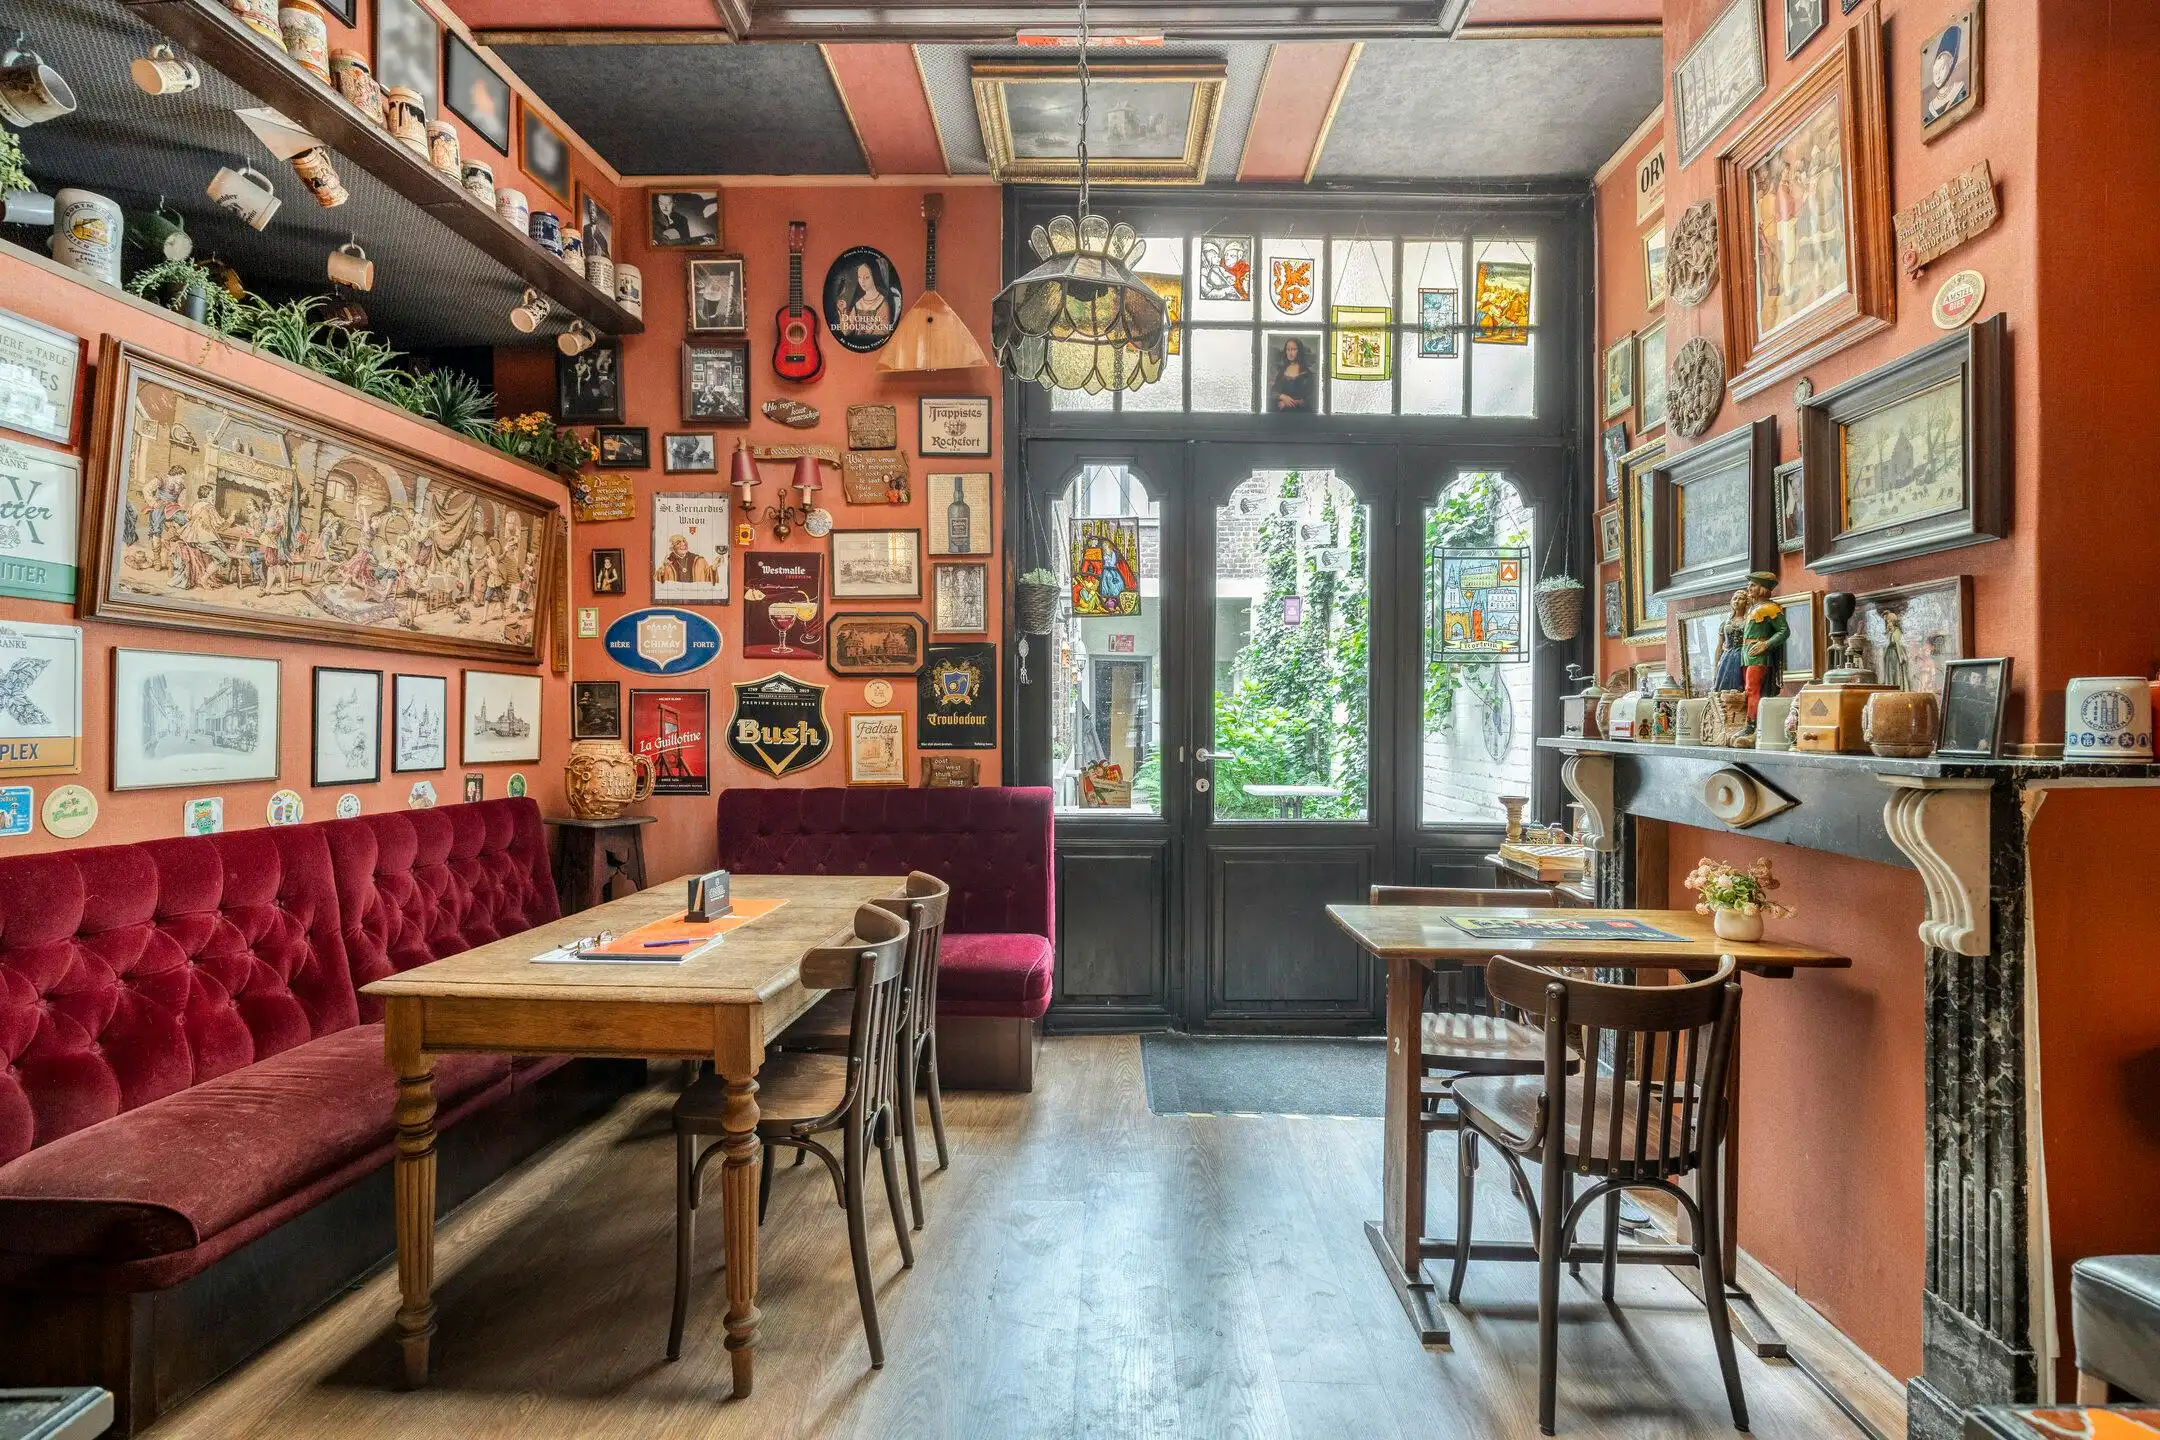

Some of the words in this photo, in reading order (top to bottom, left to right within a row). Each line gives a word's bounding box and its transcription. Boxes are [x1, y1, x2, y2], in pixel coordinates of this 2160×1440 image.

[1944, 287, 1972, 304] AMSTEL
[1949, 299, 1966, 311] BIER
[841, 313, 882, 322] DUCHESSE
[843, 322, 894, 332] BOURGOGNE
[36, 347, 68, 366] TABLE
[929, 406, 982, 423] Trappistes
[931, 436, 980, 449] Rochefort
[660, 504, 674, 513] St.
[675, 503, 724, 513] Bernardus
[679, 515, 705, 525] Watou
[761, 565, 806, 575] Westmalle
[610, 640, 631, 648] BIÈRE
[643, 640, 681, 649] CHIMAY
[927, 712, 988, 726] Troubadour
[735, 719, 822, 746] Bush
[857, 721, 898, 738] Fadista
[640, 740, 652, 752] La
[654, 731, 701, 748] Guillotine
[0, 743, 39, 761] PLEX
